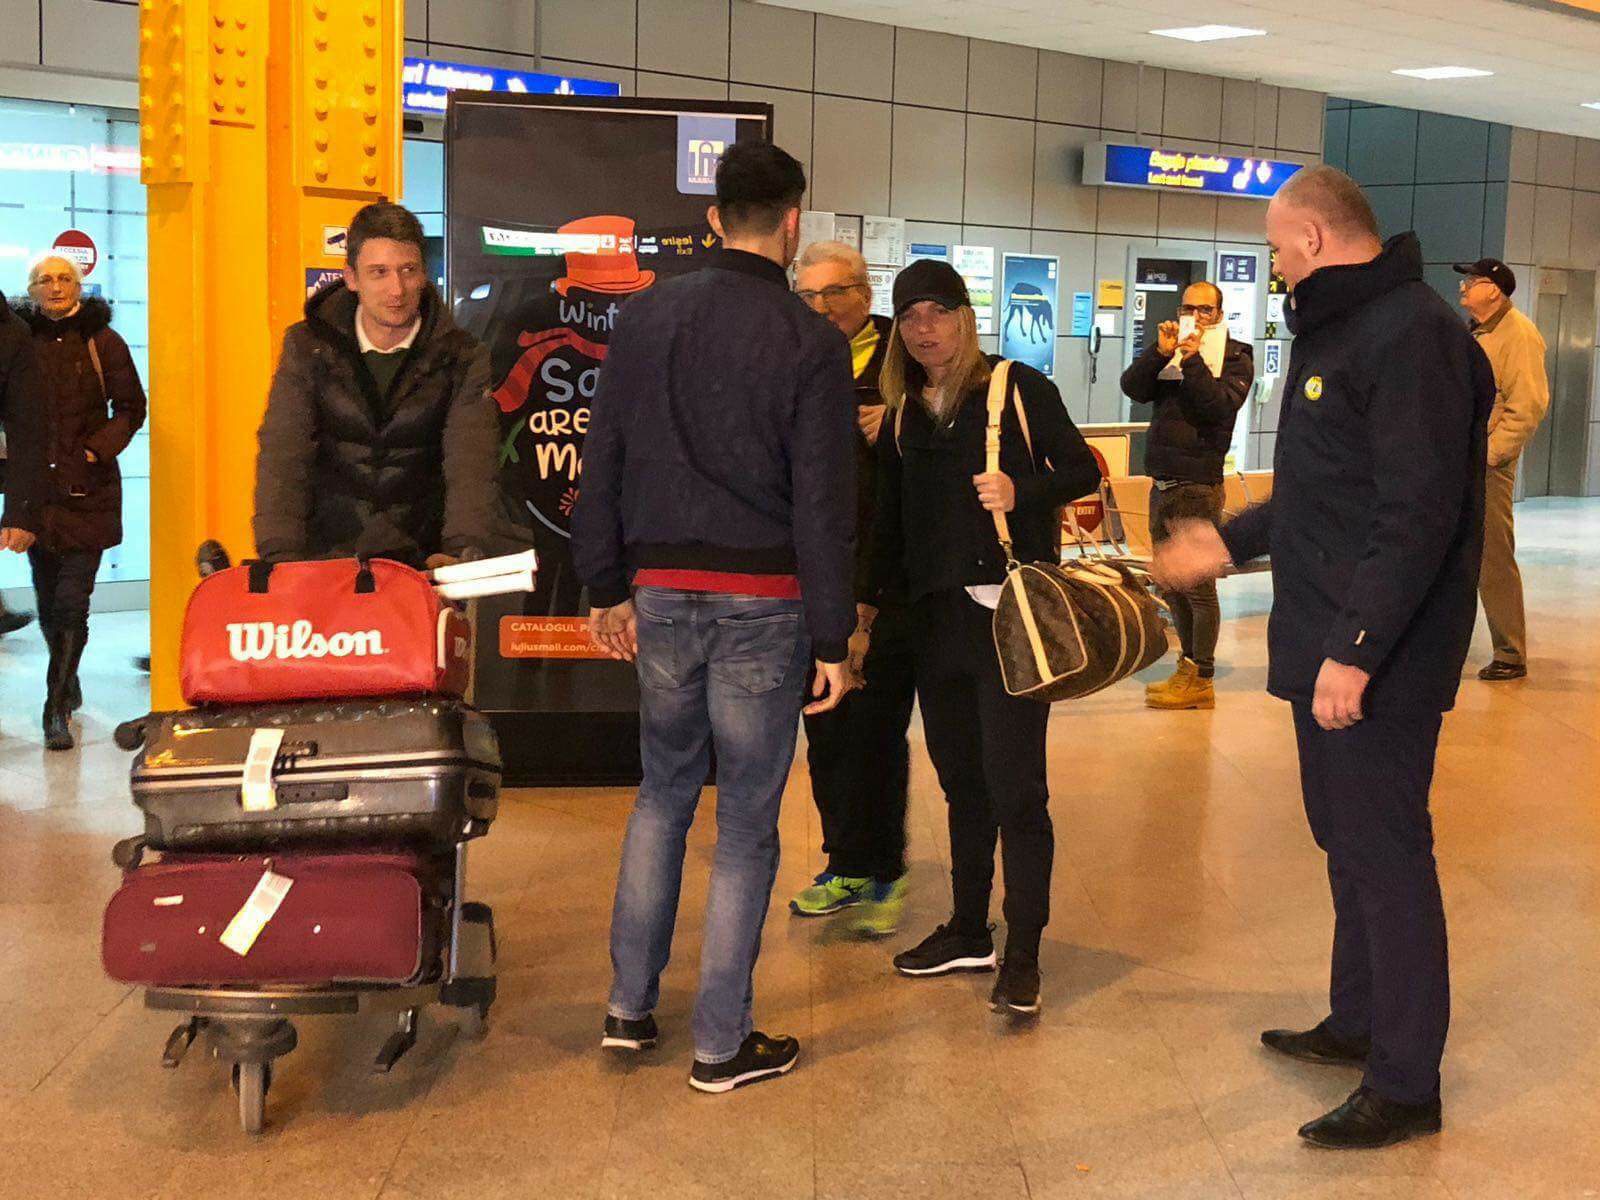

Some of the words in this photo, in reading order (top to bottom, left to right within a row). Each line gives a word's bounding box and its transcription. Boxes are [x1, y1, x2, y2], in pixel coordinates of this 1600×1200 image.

[319, 272, 343, 282] ATE
[559, 300, 620, 331] Wint
[541, 358, 600, 402] Sa
[535, 442, 583, 481] M
[226, 620, 386, 662] Wilson
[511, 623, 576, 632] CATALOGUL
[580, 624, 592, 632] P
